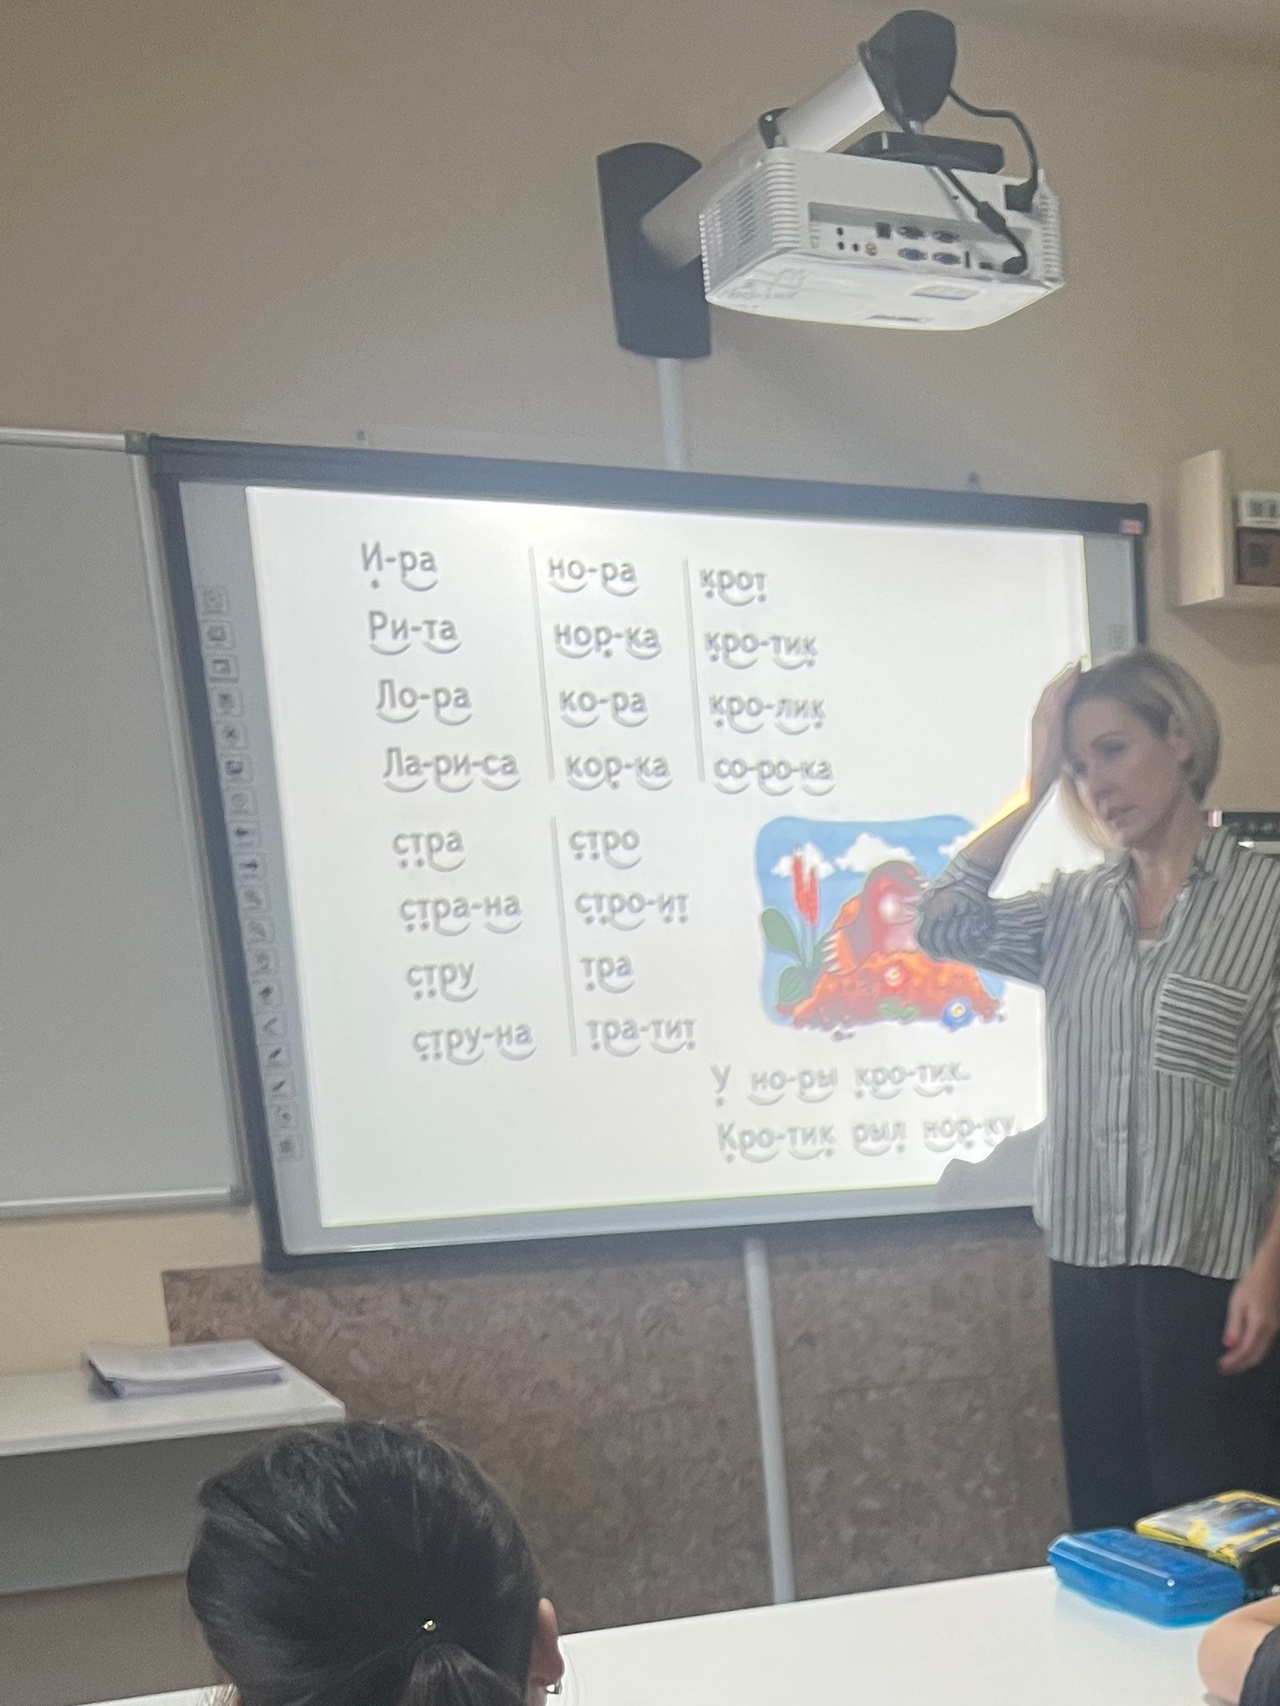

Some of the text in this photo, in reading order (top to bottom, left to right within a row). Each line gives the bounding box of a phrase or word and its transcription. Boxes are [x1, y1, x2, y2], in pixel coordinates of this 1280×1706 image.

[361, 541, 438, 580] И-ра
[548, 557, 637, 588] но-ра
[699, 569, 767, 596] крот
[369, 610, 458, 641] Ри-та
[553, 623, 661, 653] нор-ка
[704, 632, 818, 660] кро-тик
[376, 678, 473, 716] Ло-ра
[559, 690, 648, 717] ко-ра
[709, 695, 826, 720] кро-лик
[383, 746, 519, 784] Ла-ри-са
[565, 755, 672, 783] кор-ка
[713, 757, 834, 786] со-ро-ка
[393, 830, 464, 861] стра
[568, 829, 641, 857] стро
[399, 894, 522, 927] стра-на
[574, 892, 690, 921] стро-ит
[406, 961, 475, 994] стру
[579, 955, 634, 983] тра
[412, 1023, 533, 1058] стру-на
[584, 1018, 697, 1047] тра-тит
[710, 1064, 731, 1094] У
[751, 1067, 838, 1097] но-ры
[717, 1121, 836, 1155] Кро-тик
[853, 1121, 907, 1151] рыл
